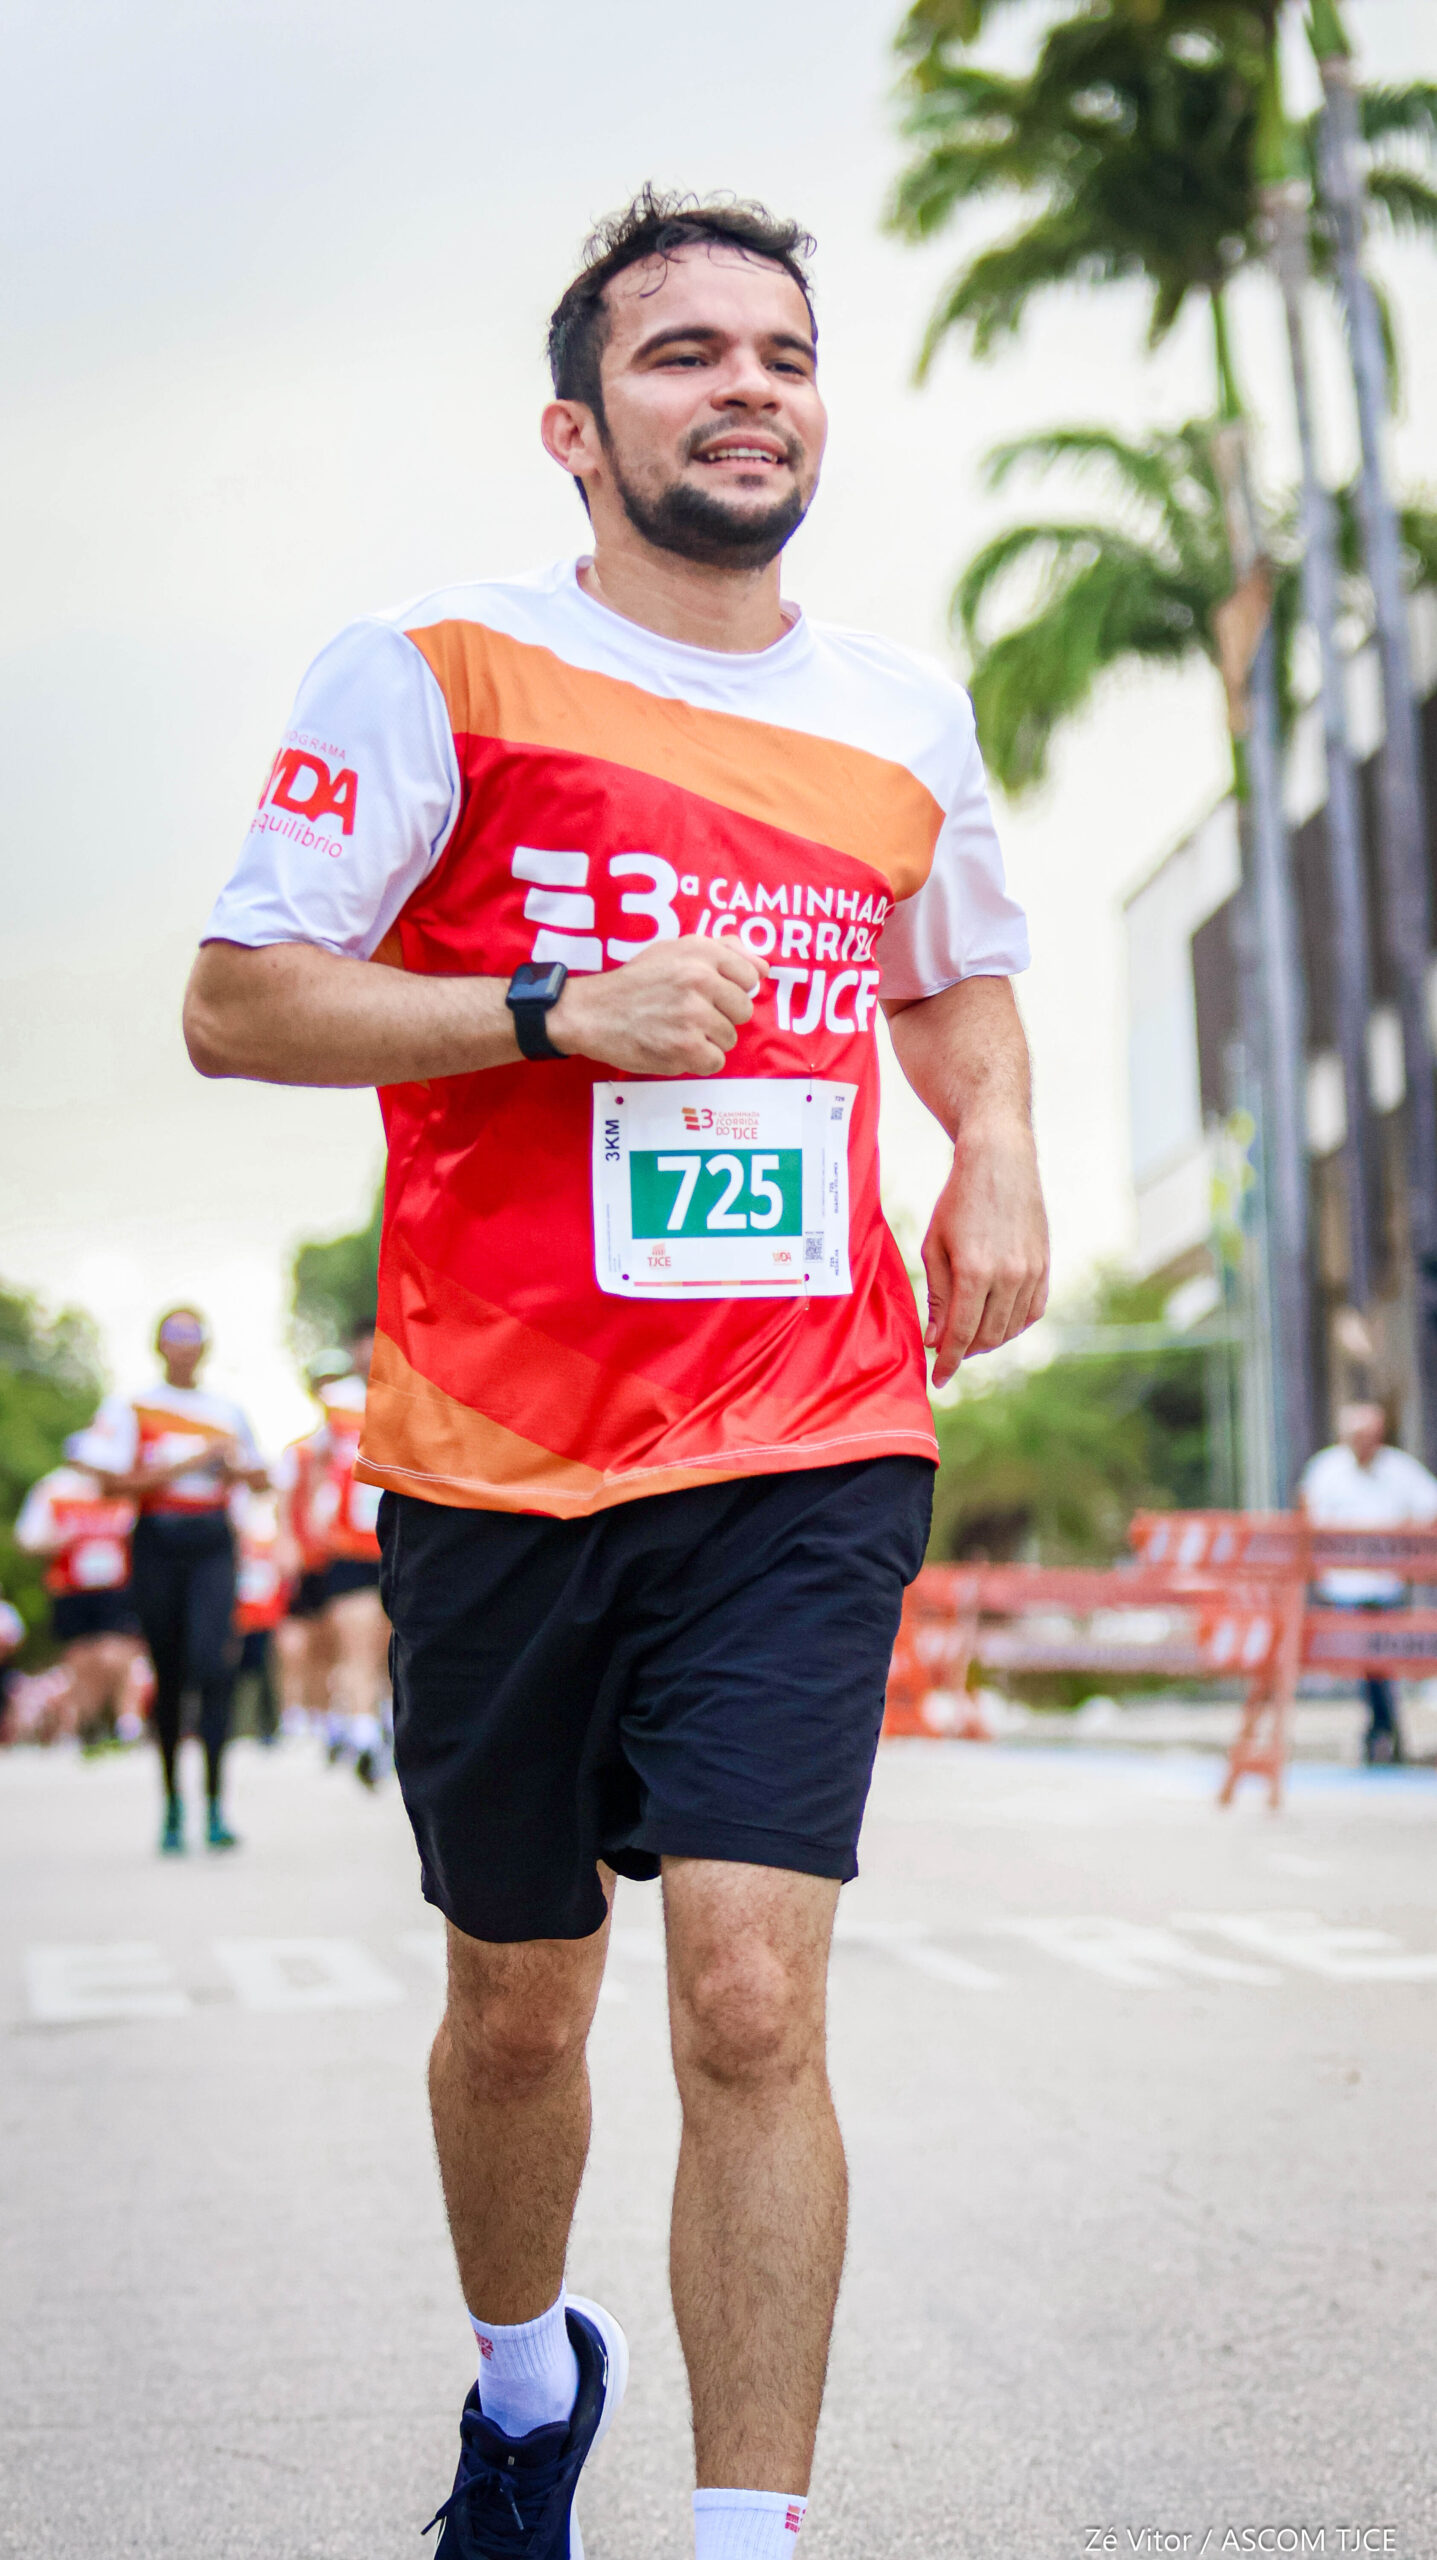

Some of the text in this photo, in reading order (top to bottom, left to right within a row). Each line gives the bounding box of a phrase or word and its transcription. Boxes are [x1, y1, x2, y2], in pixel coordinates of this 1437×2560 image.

[708, 877, 891, 927] CAMINHAD
[604, 1119, 621, 1162] 3KM
[732, 1127, 758, 1140] TJCE
[657, 1154, 784, 1231] 725
[647, 1256, 671, 1268] TJCE
